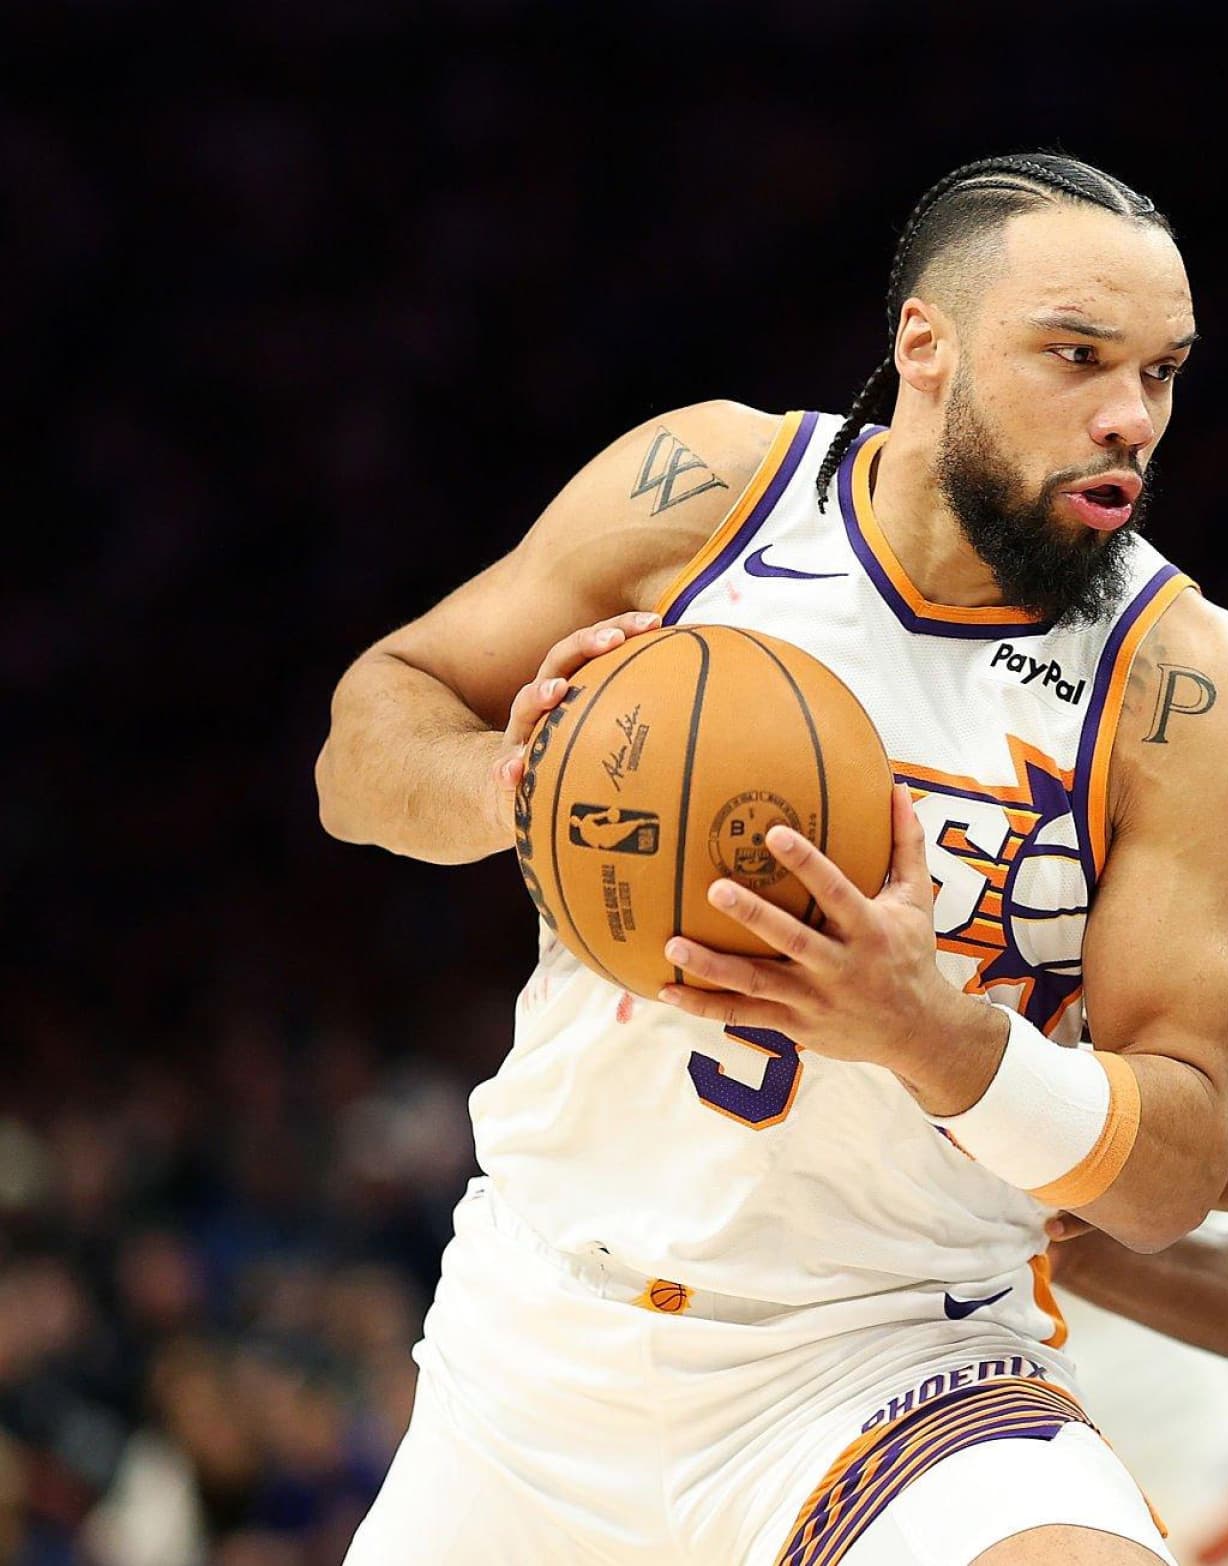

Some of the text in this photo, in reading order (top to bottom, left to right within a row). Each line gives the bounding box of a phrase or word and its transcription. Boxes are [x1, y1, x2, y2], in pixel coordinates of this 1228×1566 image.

[990, 643, 1087, 705] PayPal
[1141, 663, 1217, 744] P
[861, 1355, 1048, 1434] PHOENIX
